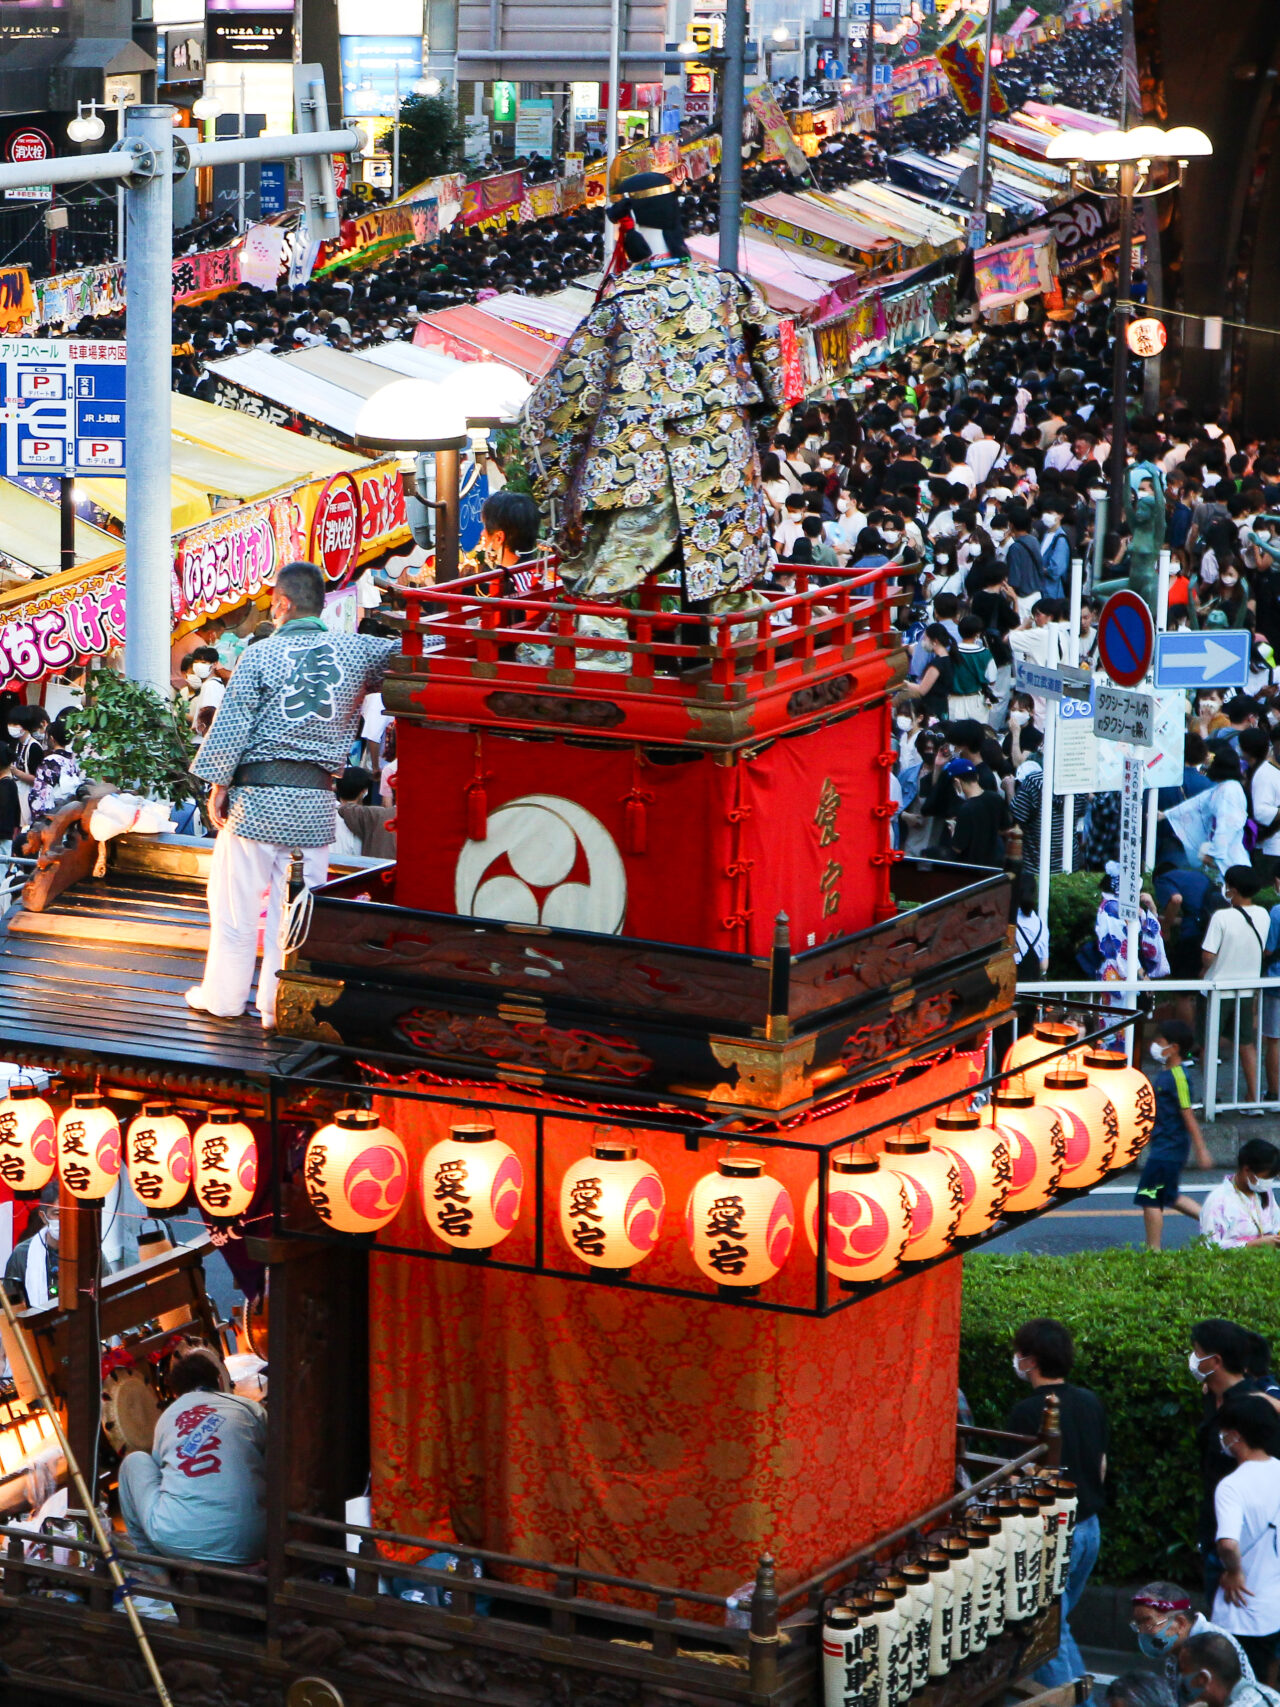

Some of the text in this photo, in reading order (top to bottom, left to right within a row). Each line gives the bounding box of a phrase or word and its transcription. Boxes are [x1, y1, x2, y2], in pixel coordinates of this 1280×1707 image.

[216, 27, 253, 35] GINZA
[15, 145, 45, 161] 消火栓
[1, 344, 127, 360] アリコベール 駐車場案内図
[33, 376, 50, 389] P
[80, 378, 90, 396] 交番
[82, 414, 121, 423] JR 上尾駅
[33, 442, 50, 455] P
[91, 443, 109, 457] P
[325, 518, 352, 552] 消火栓
[1026, 673, 1063, 694] 県立武道館
[814, 777, 843, 943] 愛宕
[62, 1120, 91, 1192] 愛宕
[133, 1129, 163, 1199] 愛宕
[201, 1136, 232, 1208] 愛宕
[434, 1159, 474, 1237] 愛宕
[569, 1177, 606, 1257] 愛宕
[705, 1195, 748, 1276] 愛宕
